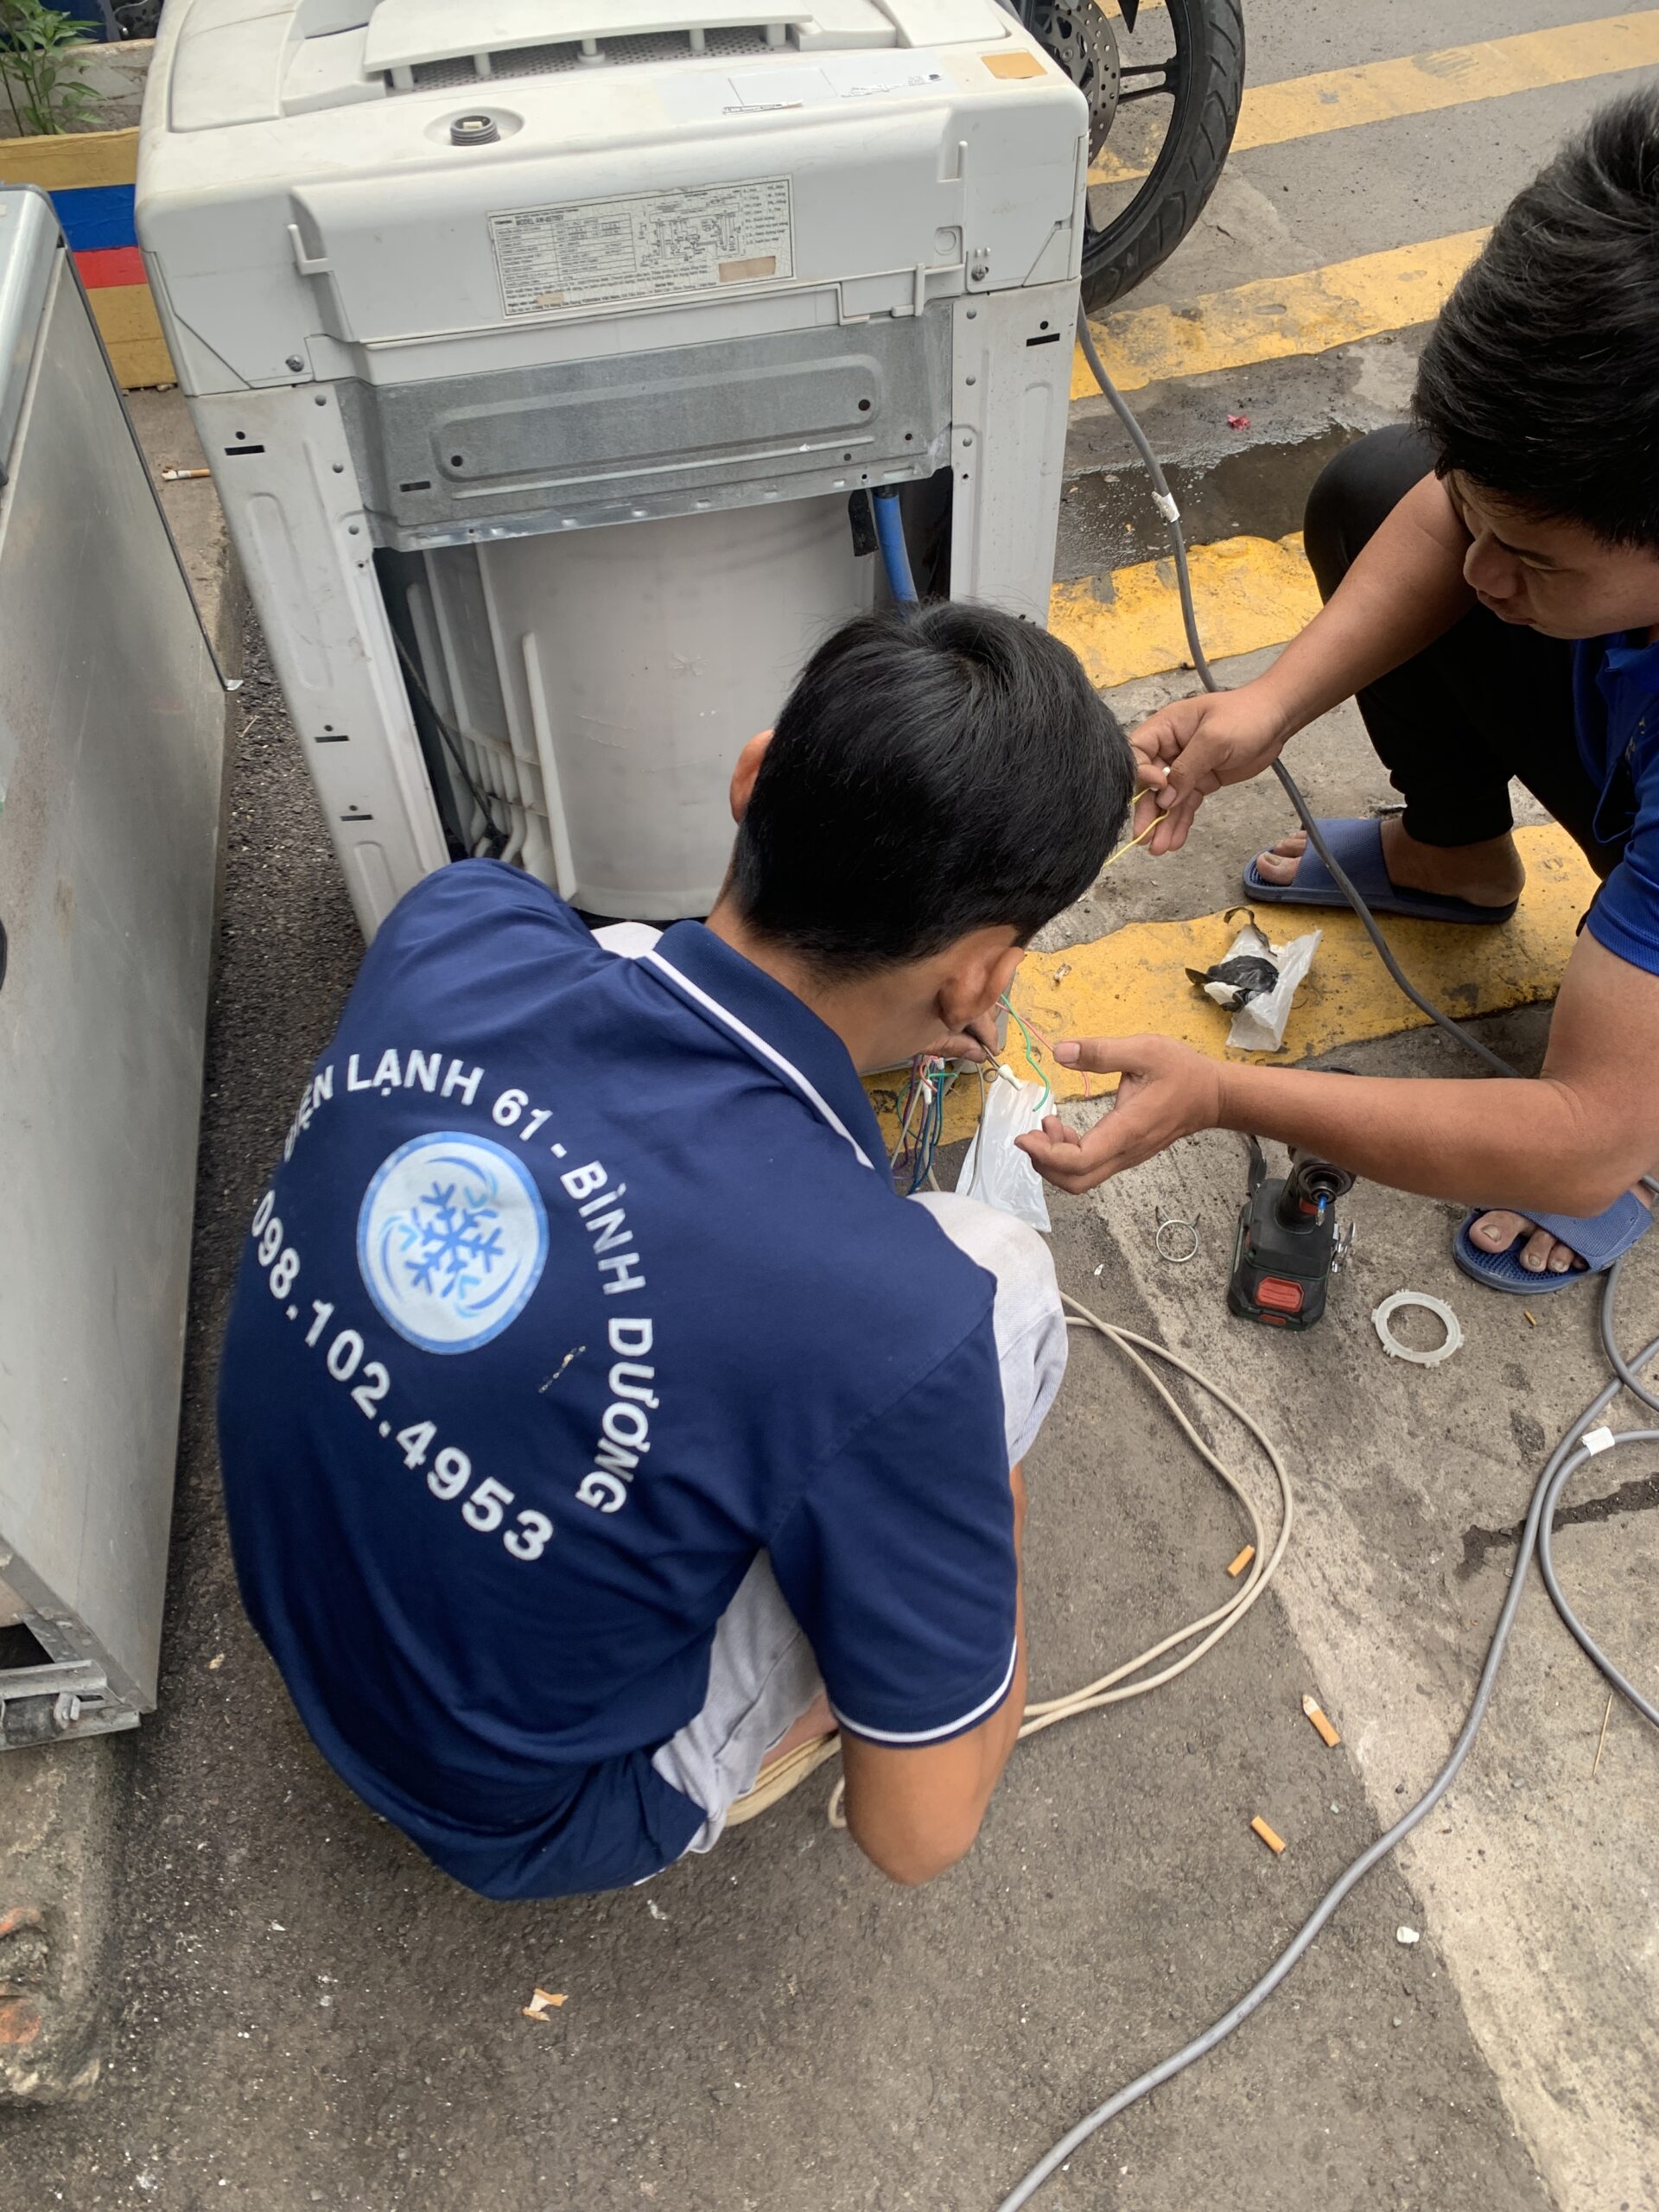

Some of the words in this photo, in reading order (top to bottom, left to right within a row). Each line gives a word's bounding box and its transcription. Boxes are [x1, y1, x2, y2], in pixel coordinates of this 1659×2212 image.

[346, 1048, 485, 1105] LẠNH
[492, 1088, 553, 1141] 61
[560, 1160, 646, 1294] BÌNH
[251, 1190, 554, 1560] 098.102.4953
[575, 1318, 660, 1514] DƯƠNG
